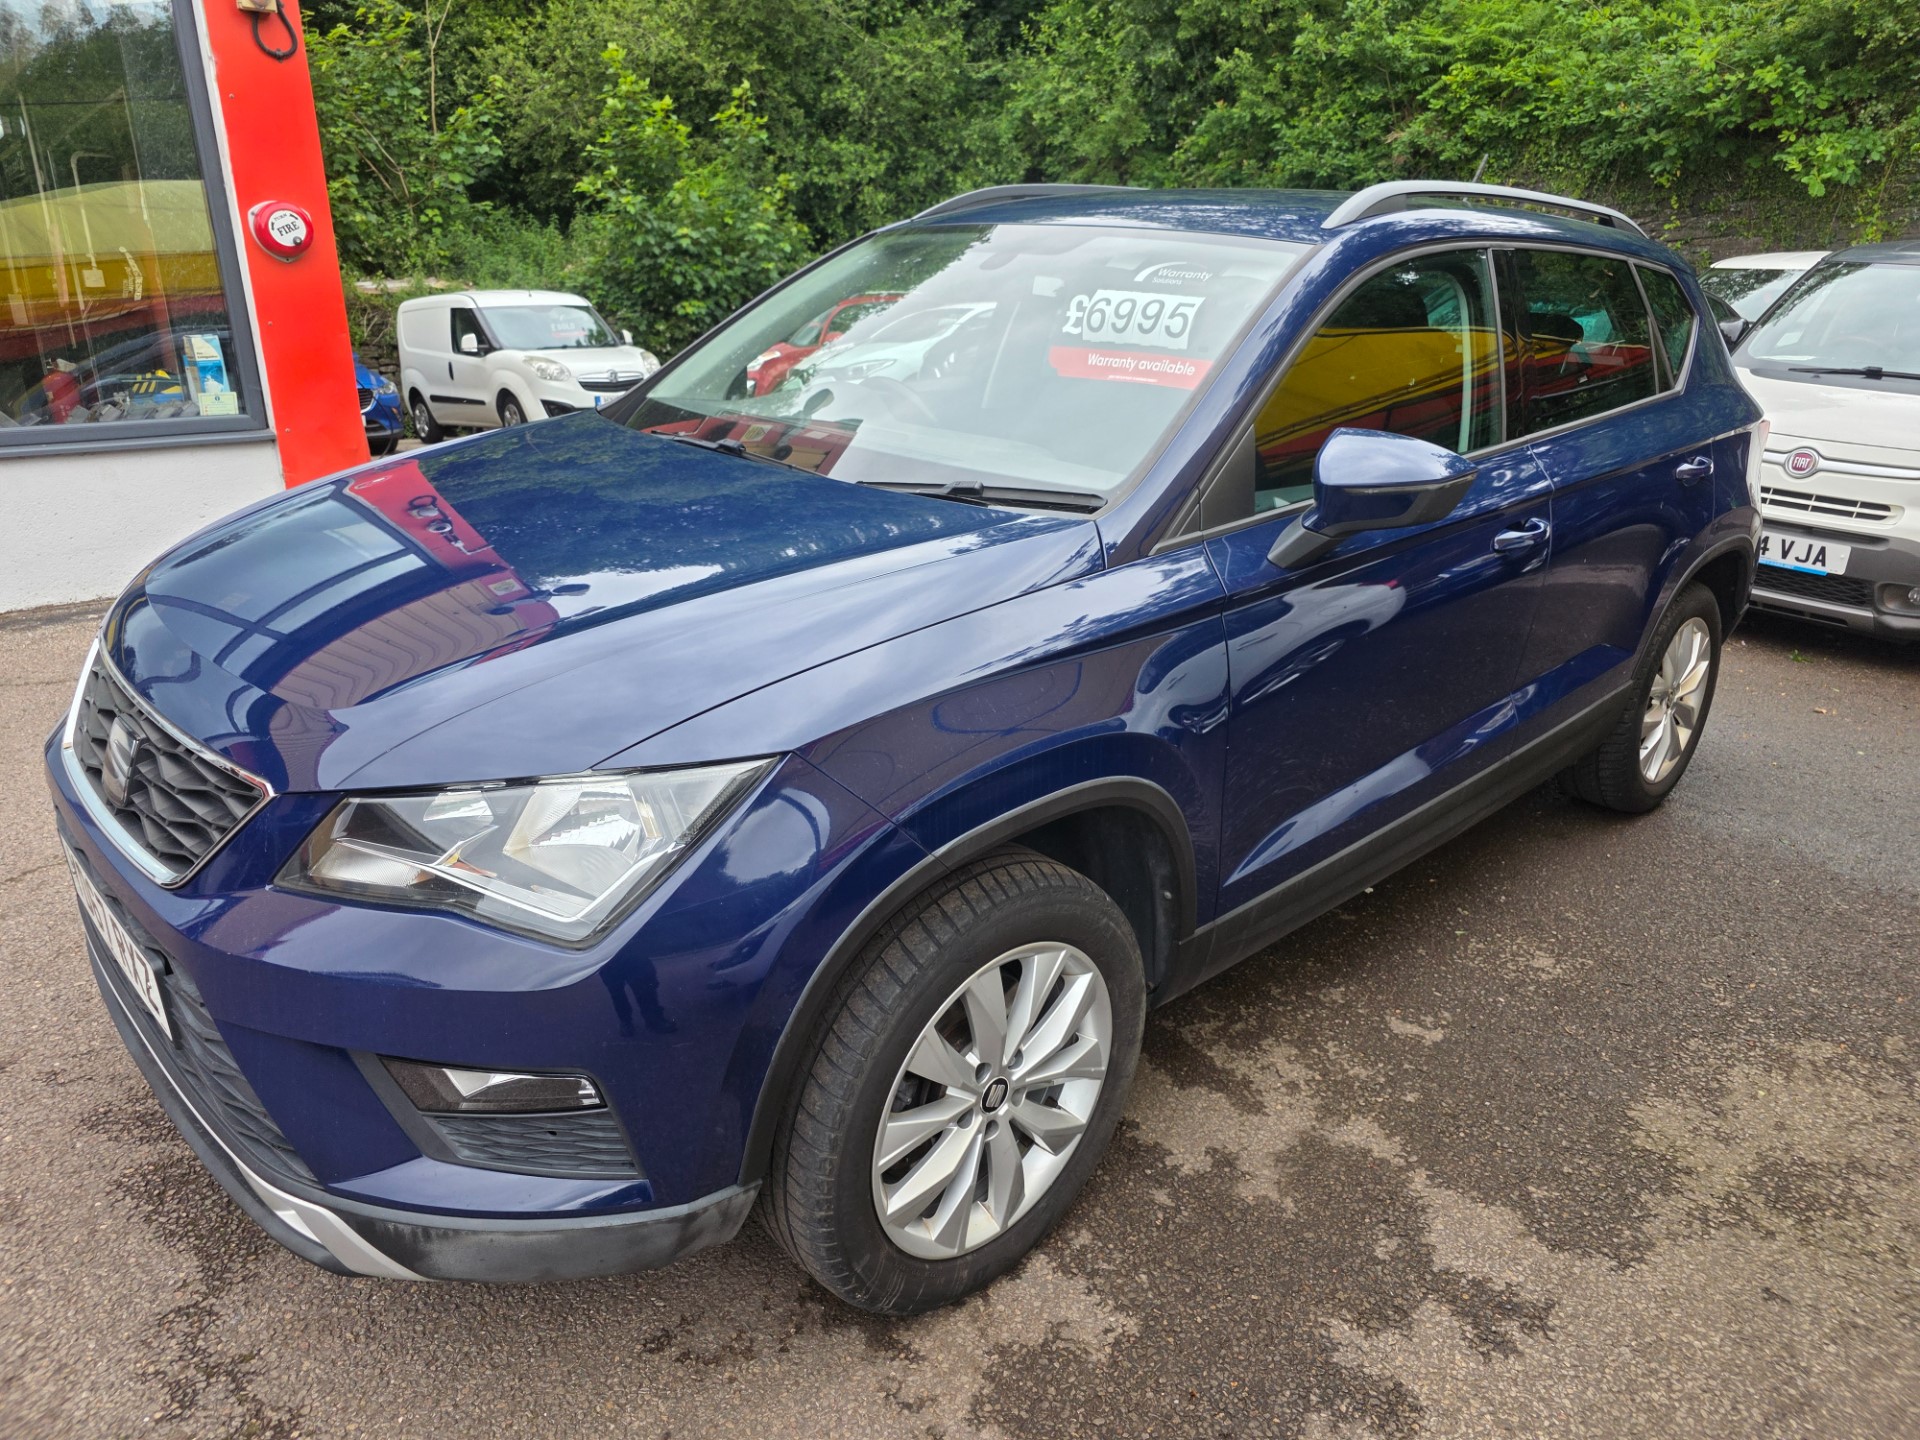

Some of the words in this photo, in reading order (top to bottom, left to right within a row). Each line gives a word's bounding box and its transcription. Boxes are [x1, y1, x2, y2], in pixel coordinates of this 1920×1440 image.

[277, 221, 300, 236] FIRE
[1158, 268, 1213, 282] Warranty
[1062, 294, 1196, 339] £6995
[1088, 353, 1137, 371] Warranty
[1138, 360, 1196, 376] available
[1793, 456, 1811, 469] FIAT
[1781, 538, 1827, 567] VJA
[109, 913, 161, 1016] RXZ
